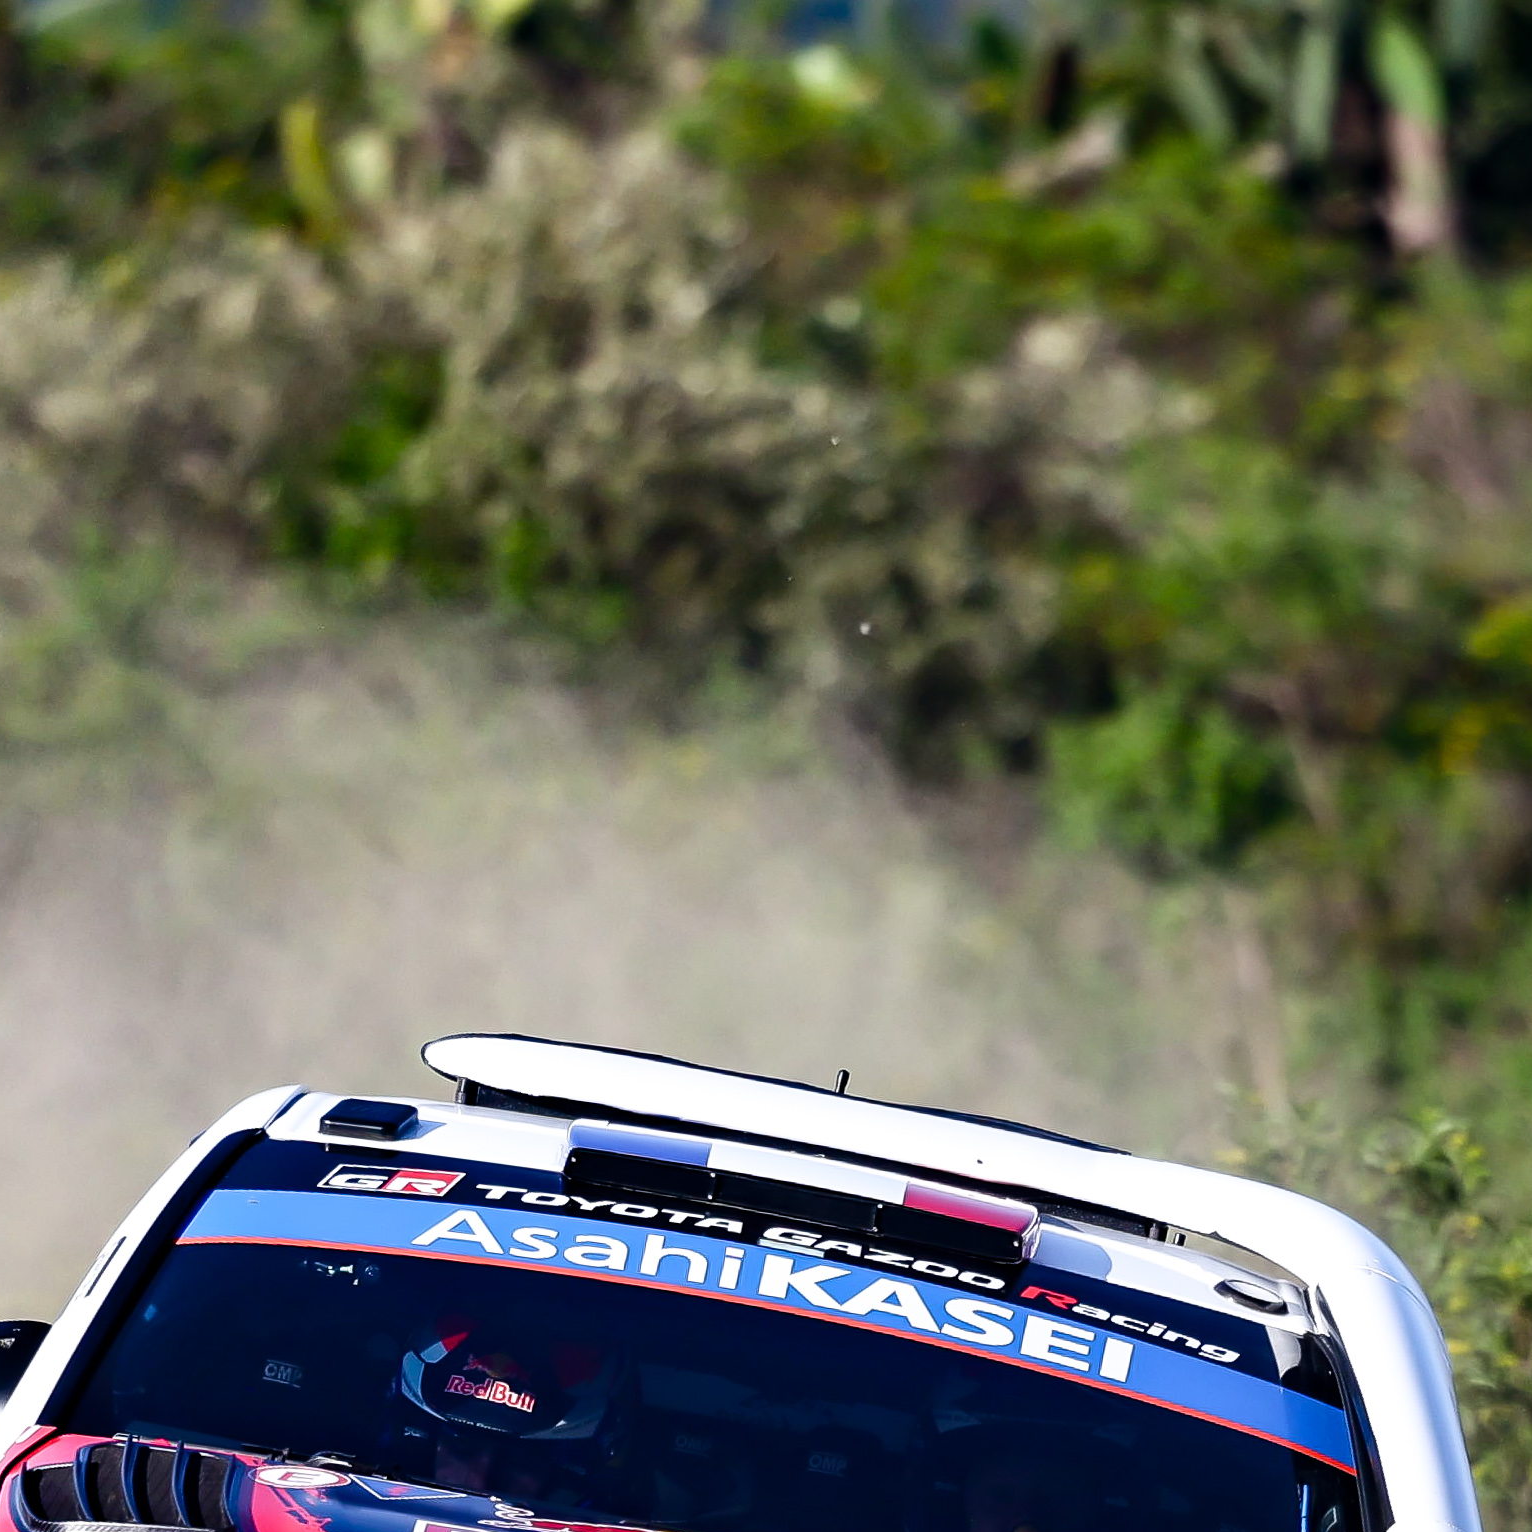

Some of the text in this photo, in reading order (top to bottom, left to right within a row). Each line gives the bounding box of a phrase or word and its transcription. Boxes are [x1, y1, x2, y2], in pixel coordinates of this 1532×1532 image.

[325, 1171, 450, 1197] GR
[474, 1183, 1242, 1364] TOYOTA GAZOO Racing
[444, 1374, 536, 1413] Red Bull
